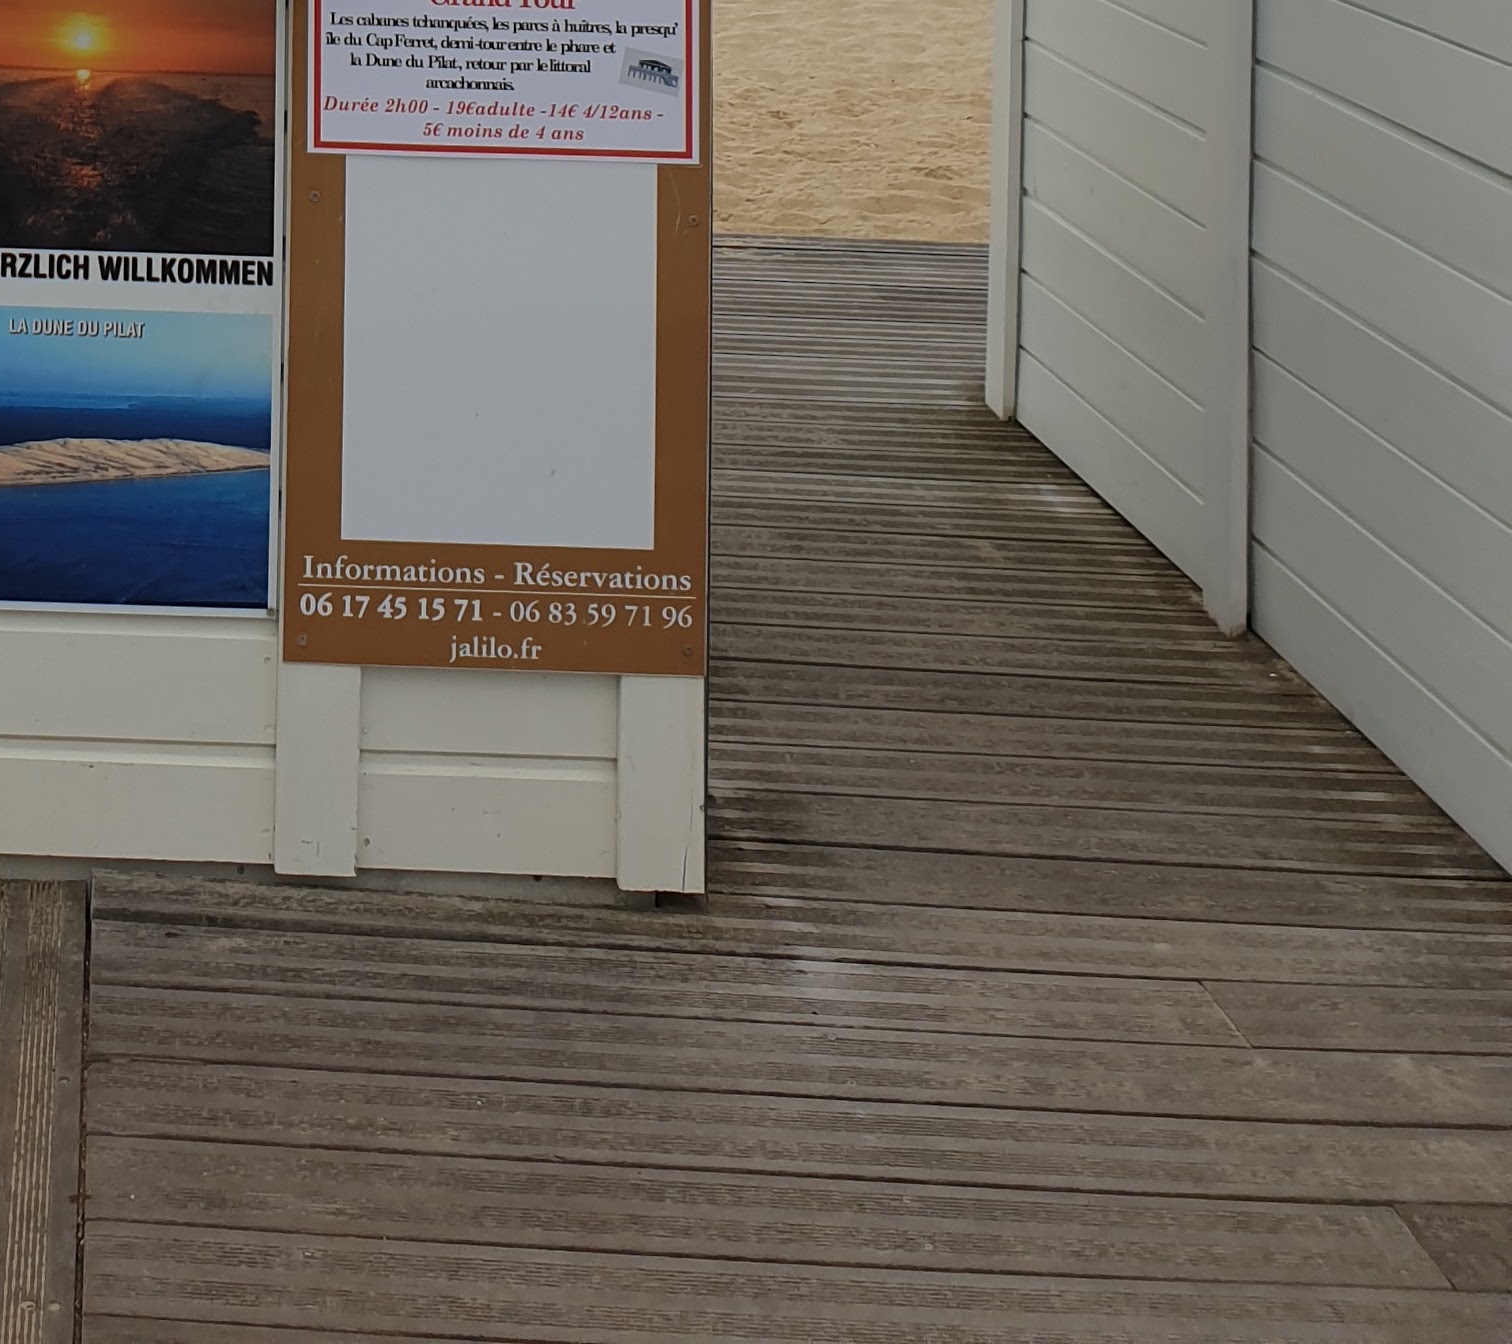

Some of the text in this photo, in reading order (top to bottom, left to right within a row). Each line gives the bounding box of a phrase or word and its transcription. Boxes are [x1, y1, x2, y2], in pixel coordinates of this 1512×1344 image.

[98, 255, 275, 287] WILLKOMMEN
[8, 318, 145, 339] LA DUNE DU PILAT
[302, 554, 691, 592] Informations Réservations
[449, 636, 543, 663] jalilo.fr
